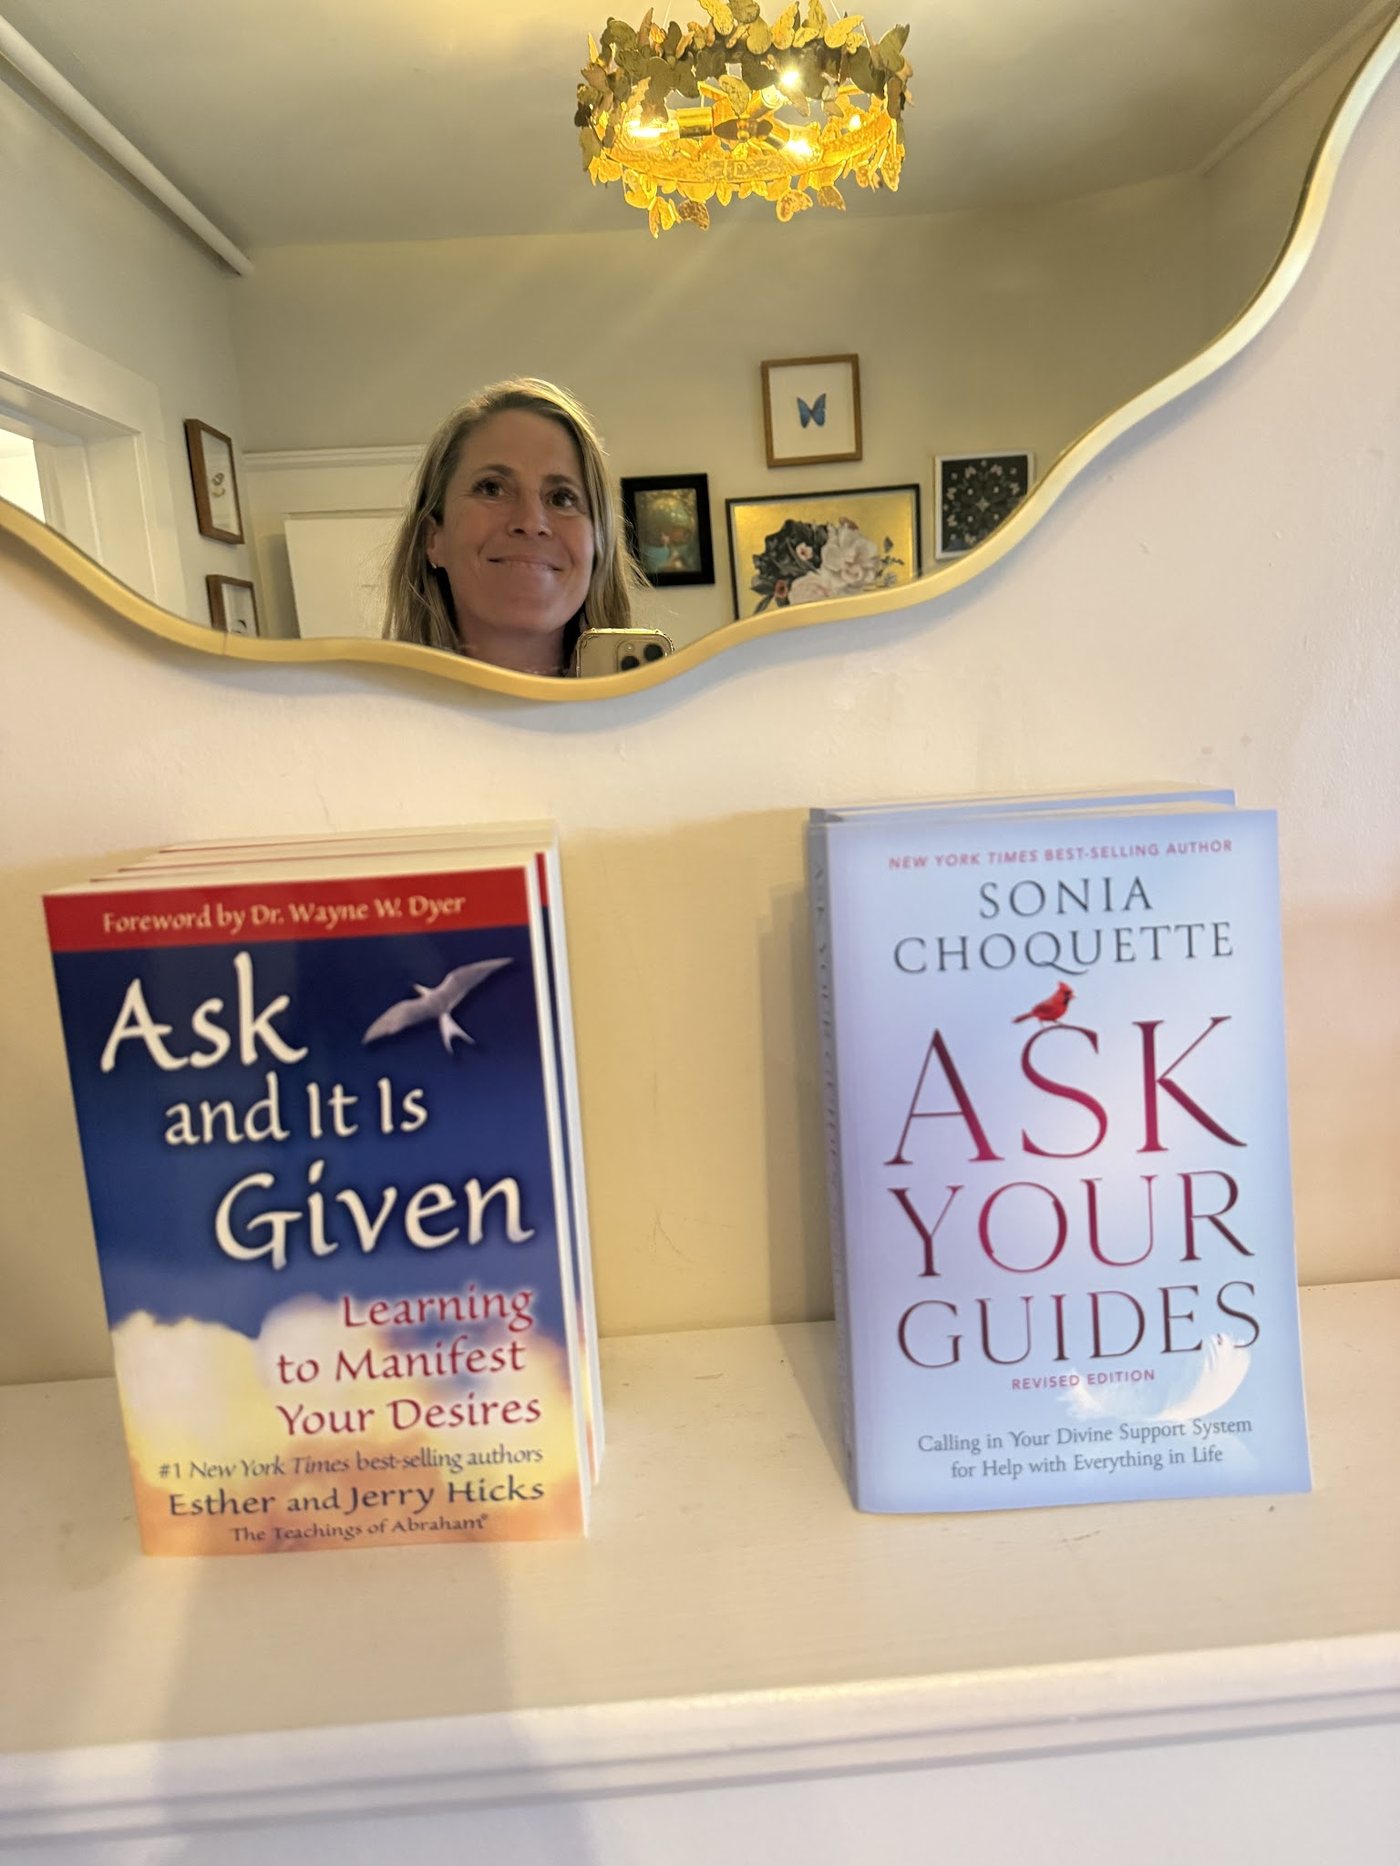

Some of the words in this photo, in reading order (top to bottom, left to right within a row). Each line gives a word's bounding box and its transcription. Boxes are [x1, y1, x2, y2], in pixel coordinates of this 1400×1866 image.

[889, 855, 926, 869] NEW
[934, 852, 980, 866] YORK
[988, 850, 1038, 864] TIMES
[1045, 843, 1159, 861] BEST-SELLING
[1166, 839, 1233, 855] AUTHOR
[104, 903, 211, 934] Foreword
[217, 902, 245, 933] by
[252, 903, 284, 926] Dr.
[289, 901, 368, 929] Wayne
[374, 898, 402, 919] W.
[409, 895, 466, 920] Dyer
[979, 876, 1153, 919] SONIA
[894, 921, 1234, 976] CHOQUETTE
[101, 951, 308, 1072] Ask
[165, 1071, 289, 1145] and
[308, 1082, 358, 1138] It
[378, 1078, 427, 1134] Is
[884, 1016, 1248, 1165] ASK
[215, 1160, 534, 1270] Given
[887, 1170, 1255, 1277] YOUR
[342, 1284, 534, 1332] Learning
[898, 1281, 1260, 1369] GUIDES
[277, 1353, 319, 1384] to
[336, 1335, 526, 1382] Manifest
[1012, 1374, 1080, 1391] REVISED
[1087, 1369, 1155, 1385] EDITION
[277, 1403, 374, 1436] Your
[387, 1392, 541, 1431] Desires
[917, 1434, 981, 1455] Calling
[987, 1433, 1004, 1450] in
[1009, 1428, 1049, 1449] Your
[1056, 1425, 1113, 1445] Divine
[1118, 1420, 1185, 1443] Support
[1192, 1418, 1252, 1438] System
[159, 1462, 183, 1479] #1
[190, 1459, 236, 1478] New
[239, 1456, 285, 1476] York
[292, 1453, 349, 1474] Times
[356, 1447, 463, 1474] best-selling
[467, 1446, 543, 1466] authors
[951, 1460, 976, 1479] for
[982, 1458, 1023, 1480] Help
[1029, 1455, 1067, 1474] with
[1073, 1449, 1163, 1473] Everything
[1168, 1447, 1185, 1465] in
[1192, 1445, 1223, 1464] Life
[169, 1488, 275, 1516] Esther
[287, 1491, 339, 1512] and
[345, 1484, 434, 1515] Jerry
[448, 1474, 545, 1503] Hicks
[231, 1526, 266, 1543] The
[272, 1522, 363, 1541] Teachings
[367, 1518, 389, 1534] of
